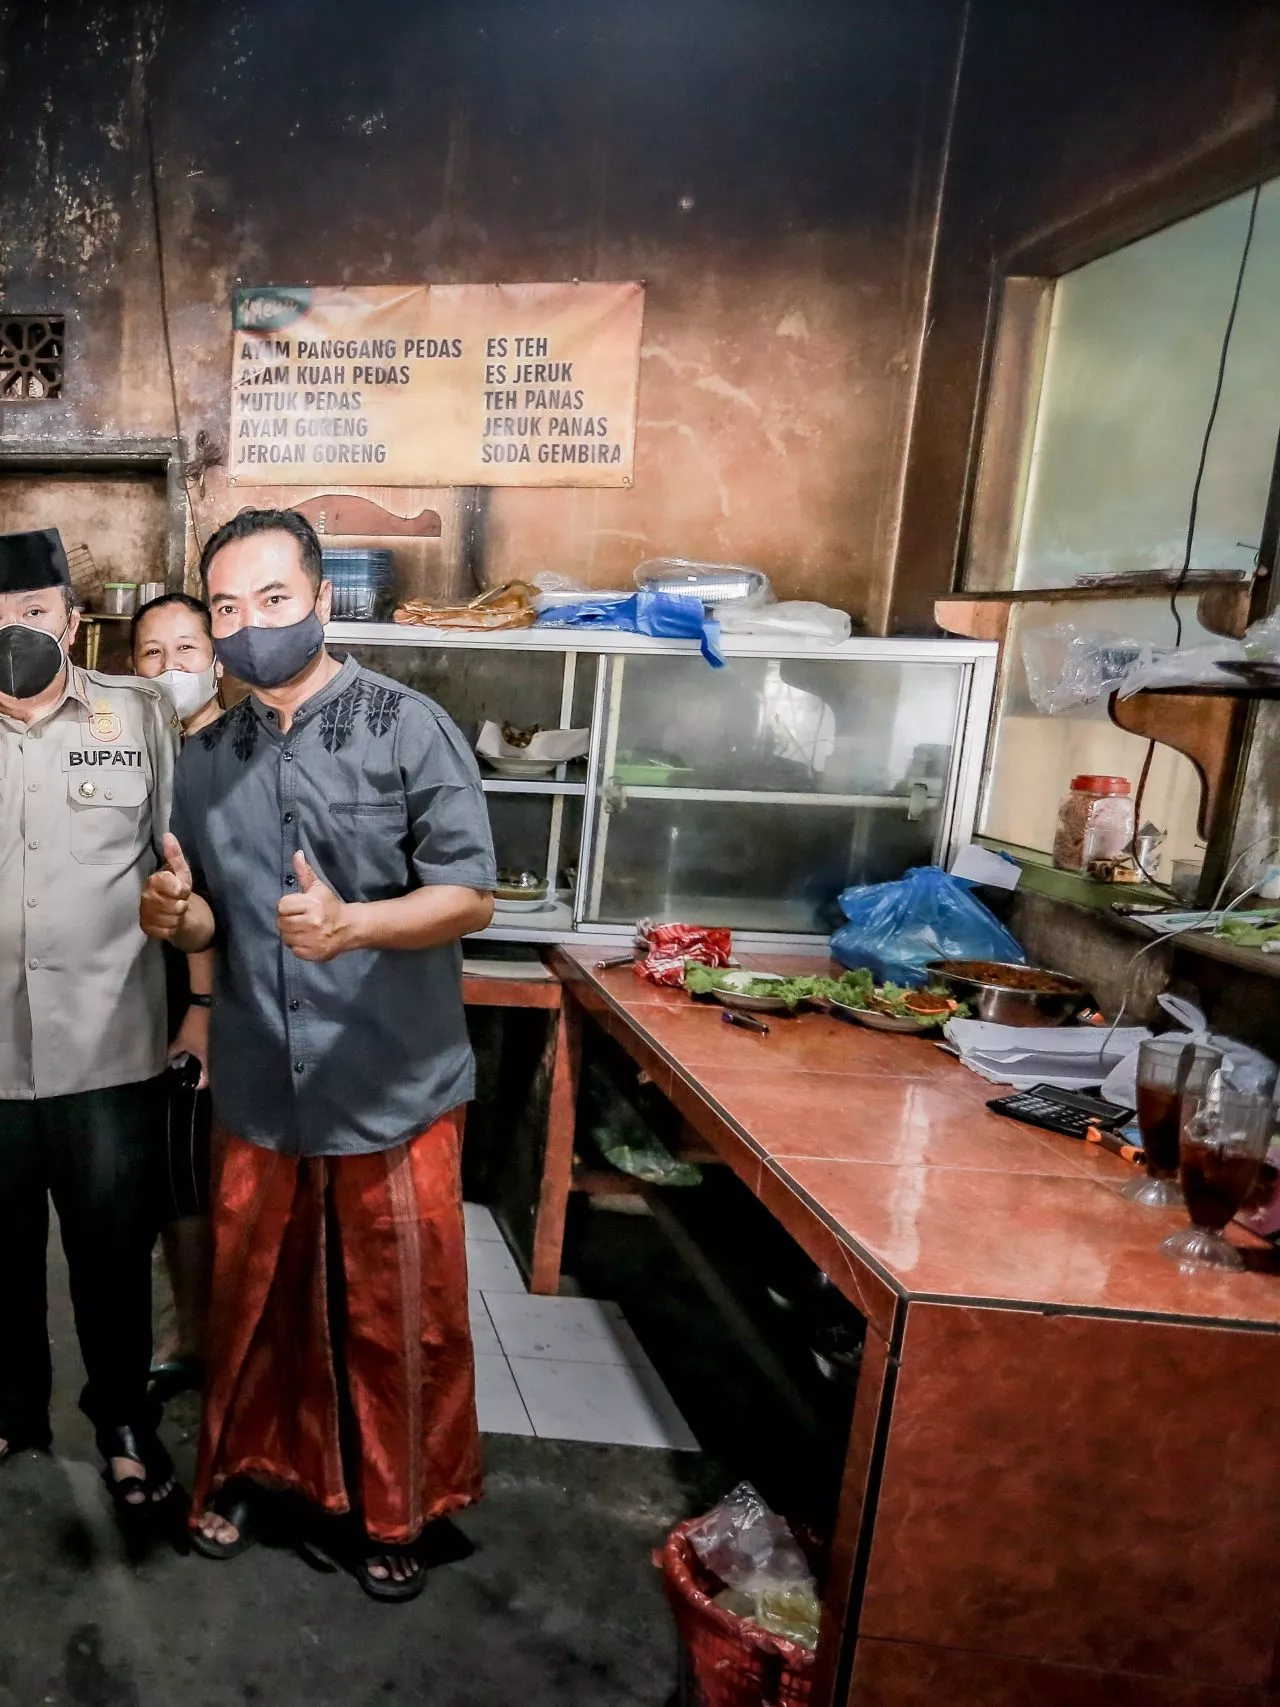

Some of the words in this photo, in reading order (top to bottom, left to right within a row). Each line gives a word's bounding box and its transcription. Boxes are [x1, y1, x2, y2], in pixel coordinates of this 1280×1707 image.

[297, 339, 397, 359] PANGGANG
[404, 338, 462, 358] PEDAS
[487, 337, 508, 357] ES
[514, 337, 548, 357] TEH
[238, 365, 290, 386] AYAM
[296, 365, 345, 385] KUAH
[352, 365, 410, 385] PEDAS
[485, 364, 507, 384] ES
[512, 362, 573, 383] JERUK
[239, 391, 298, 412] KUTUK
[304, 391, 362, 411] PEDAS
[484, 390, 517, 410] TEH
[525, 389, 584, 410] PANAS
[238, 417, 288, 438] AYAM
[295, 417, 369, 437] GORENG
[482, 416, 542, 438] JERUK
[548, 416, 608, 437] PANAS
[237, 443, 306, 464] JEROAN
[312, 443, 387, 464] GORENG
[481, 443, 531, 463] SODA
[537, 443, 622, 464] GEMBIRA
[69, 750, 142, 768] BUPATI
